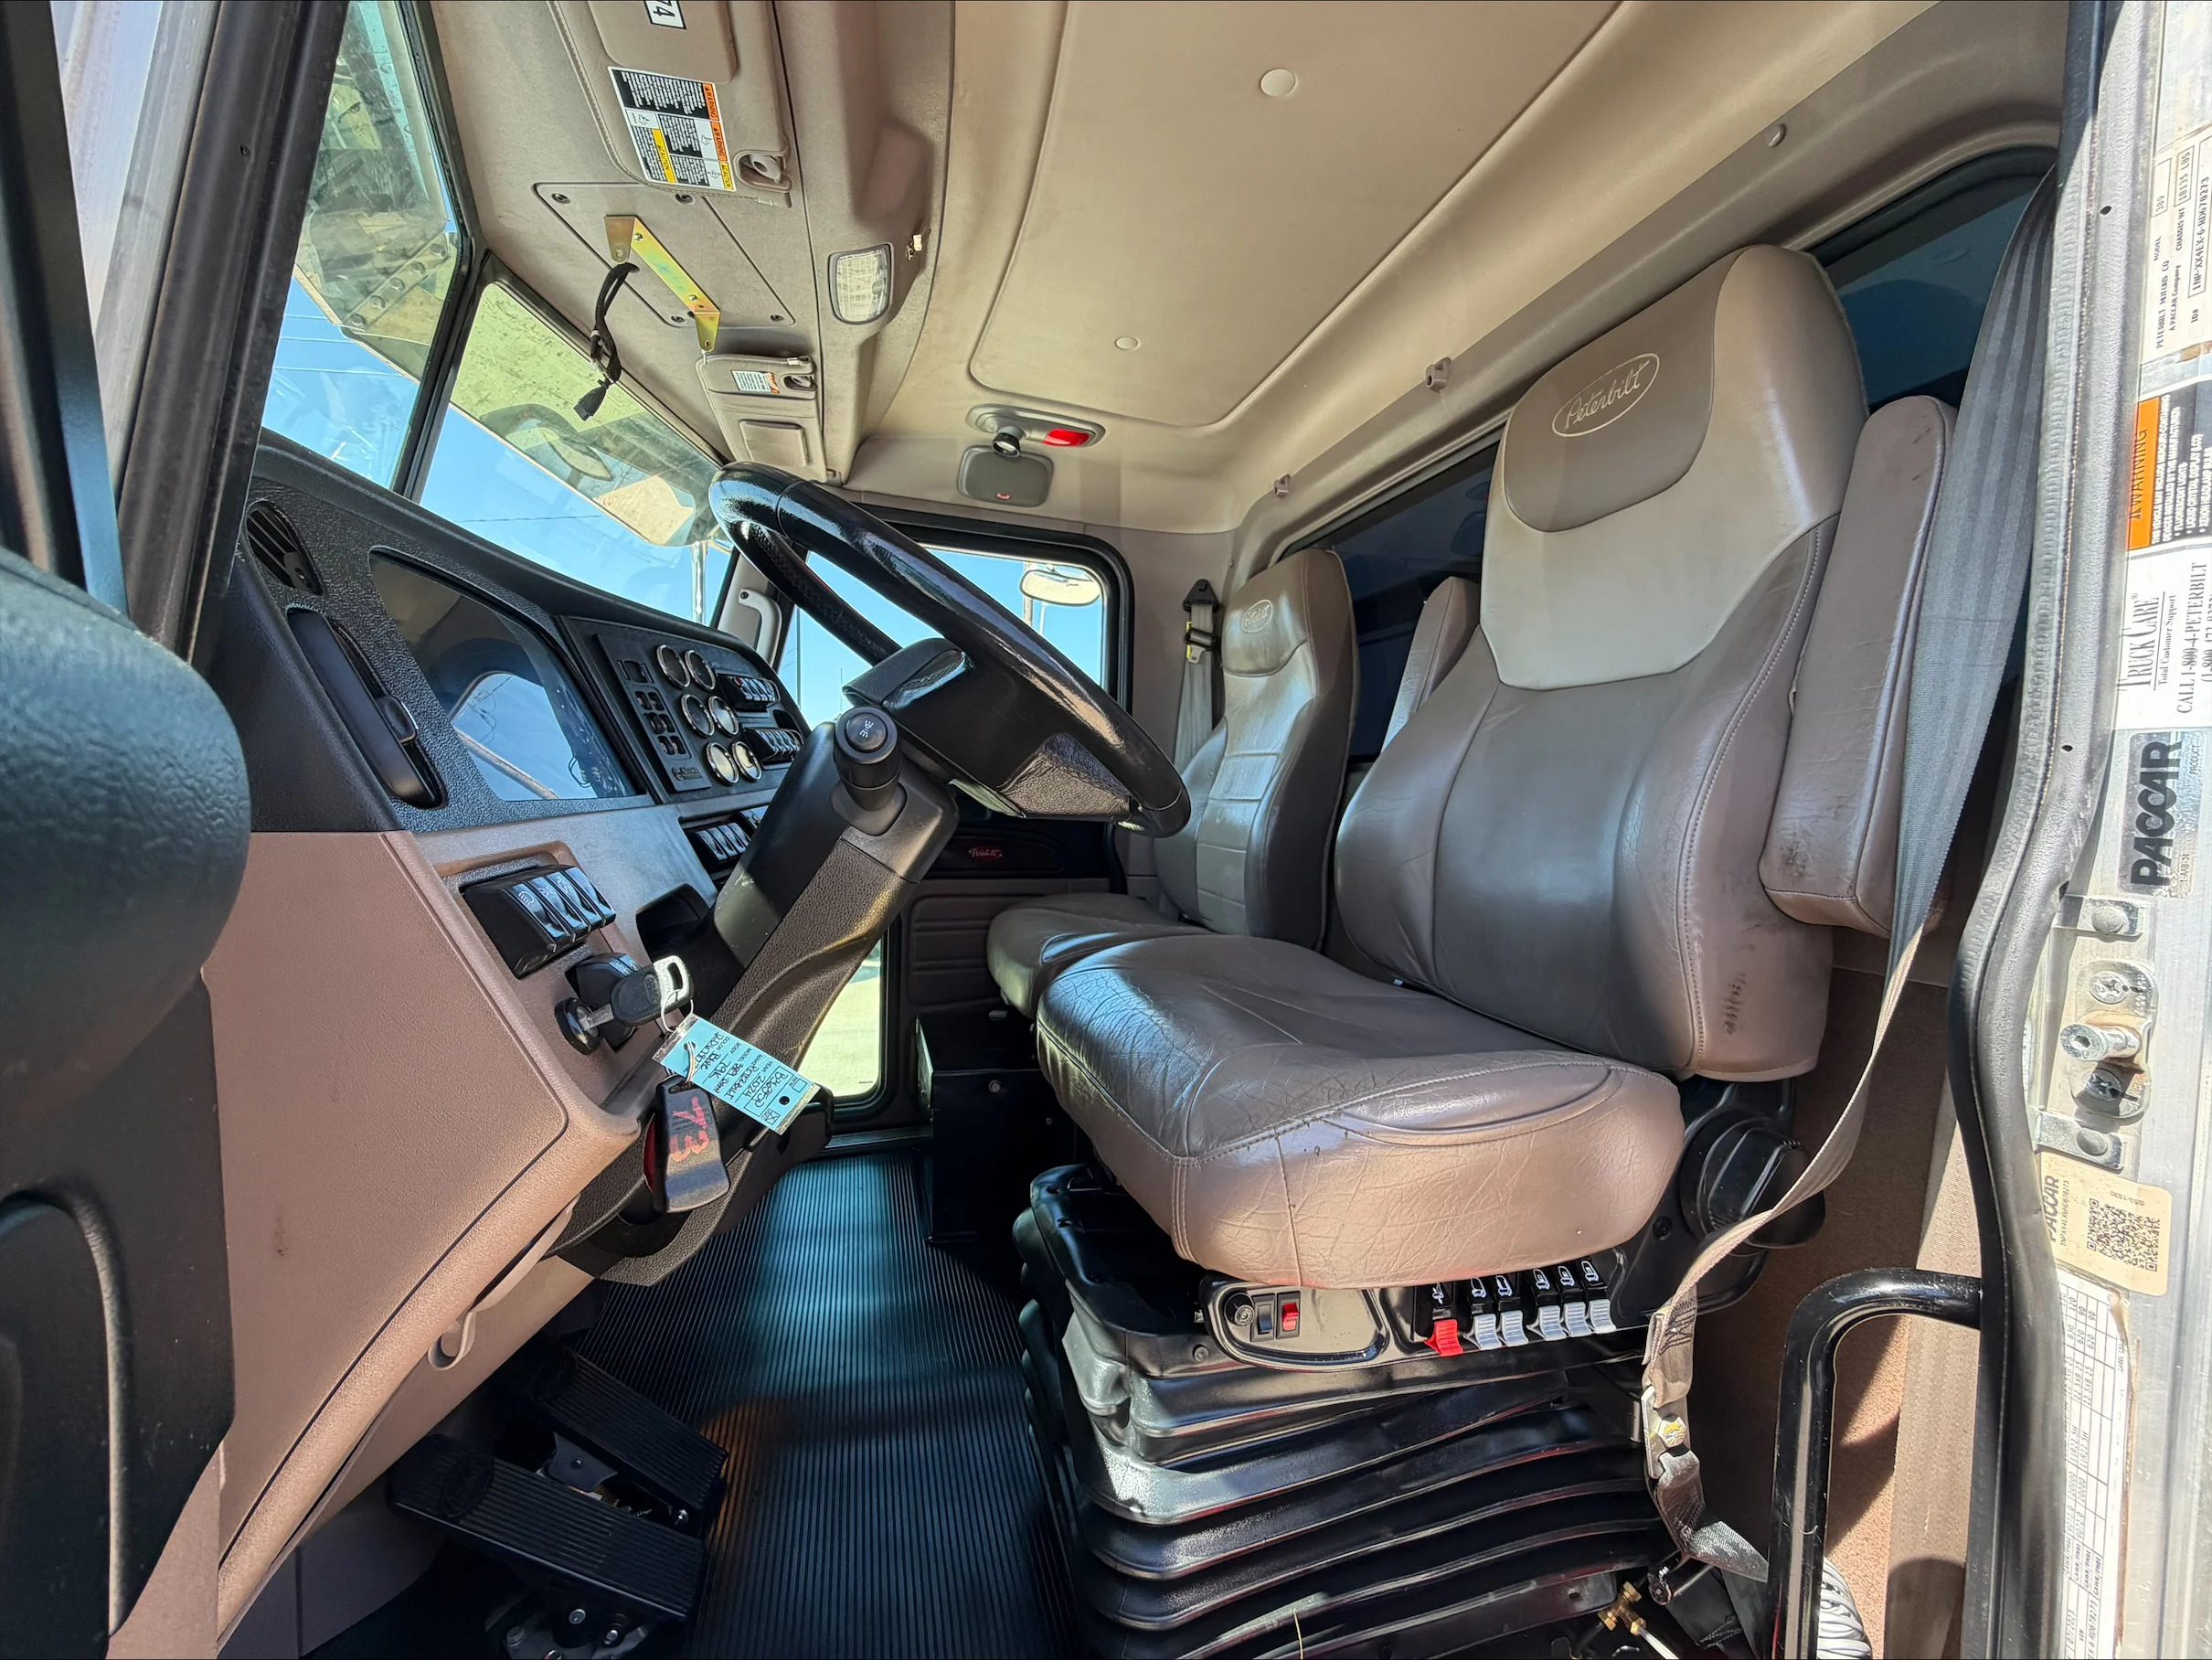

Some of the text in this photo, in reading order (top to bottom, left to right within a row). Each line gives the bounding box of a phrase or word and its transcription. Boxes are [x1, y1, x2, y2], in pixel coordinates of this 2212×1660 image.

[2172, 265, 2182, 297] Company
[2170, 297, 2178, 325] PACCAR
[2156, 308, 2166, 349] PETERBILT
[1565, 360, 1650, 430] Peterbilt
[2131, 429, 2147, 507] WARNING
[2155, 463, 2165, 491] INCLUDE
[2166, 473, 2175, 483] BY
[2167, 459, 2177, 474] THE
[2185, 433, 2204, 529] LIQUID CRYSTAL DISPLAY (LCD)
[2201, 469, 2212, 505] HEADLAMP
[2154, 491, 2164, 505] MAY
[2164, 482, 2175, 516] INSTALLED
[2174, 462, 2188, 531] FLUORESCENT LIGHTS
[2153, 504, 2164, 530] VEHICLE
[2163, 515, 2173, 542] DEVICES
[2199, 504, 2209, 527] XENON
[2158, 595, 2177, 686] Total Customer Support
[2176, 563, 2207, 714] CALL 1-800-4-PETERBILT
[2116, 639, 2155, 691] TRUCK
[2189, 745, 2200, 775] PRODUCT
[2131, 740, 2183, 886] PACCAR
[716, 1036, 729, 1050] COLOR
[729, 1042, 740, 1054] BODY
[737, 1048, 751, 1062] MODEL
[750, 1054, 762, 1065] MAKE
[742, 1060, 773, 1097] YEAR 2024
[788, 1077, 797, 1086] NEW
[2079, 1306, 2086, 1316] 90
[2088, 1311, 2096, 1321] 90
[2087, 1335, 2095, 1349] 620
